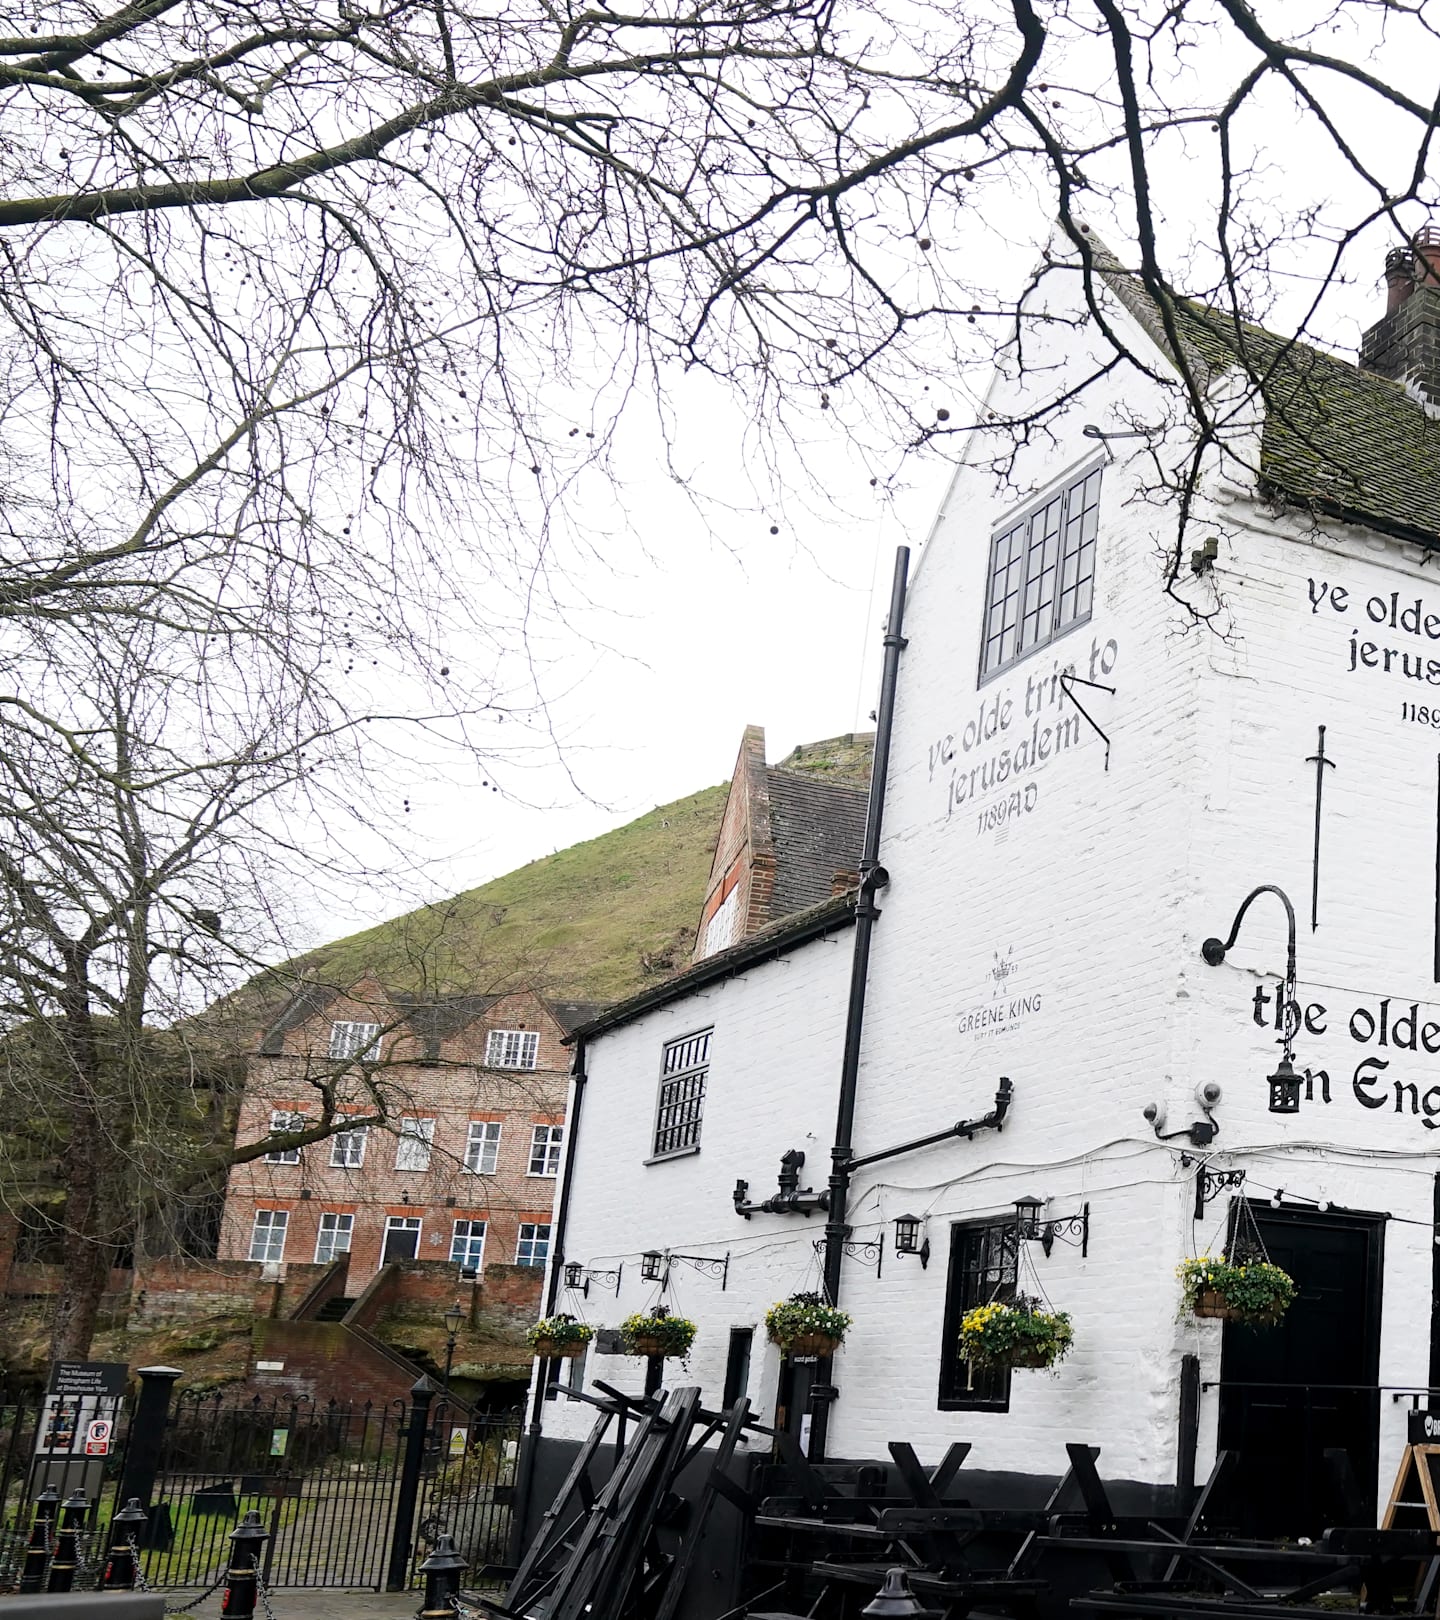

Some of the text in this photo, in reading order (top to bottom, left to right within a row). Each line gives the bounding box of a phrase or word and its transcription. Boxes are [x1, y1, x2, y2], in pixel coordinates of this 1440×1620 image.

[1307, 578, 1349, 614] ye
[928, 637, 1118, 783] ye olde trip to
[945, 712, 1080, 823] jerusalem
[959, 993, 1042, 1033] GREENE KING
[1252, 982, 1328, 1044] the
